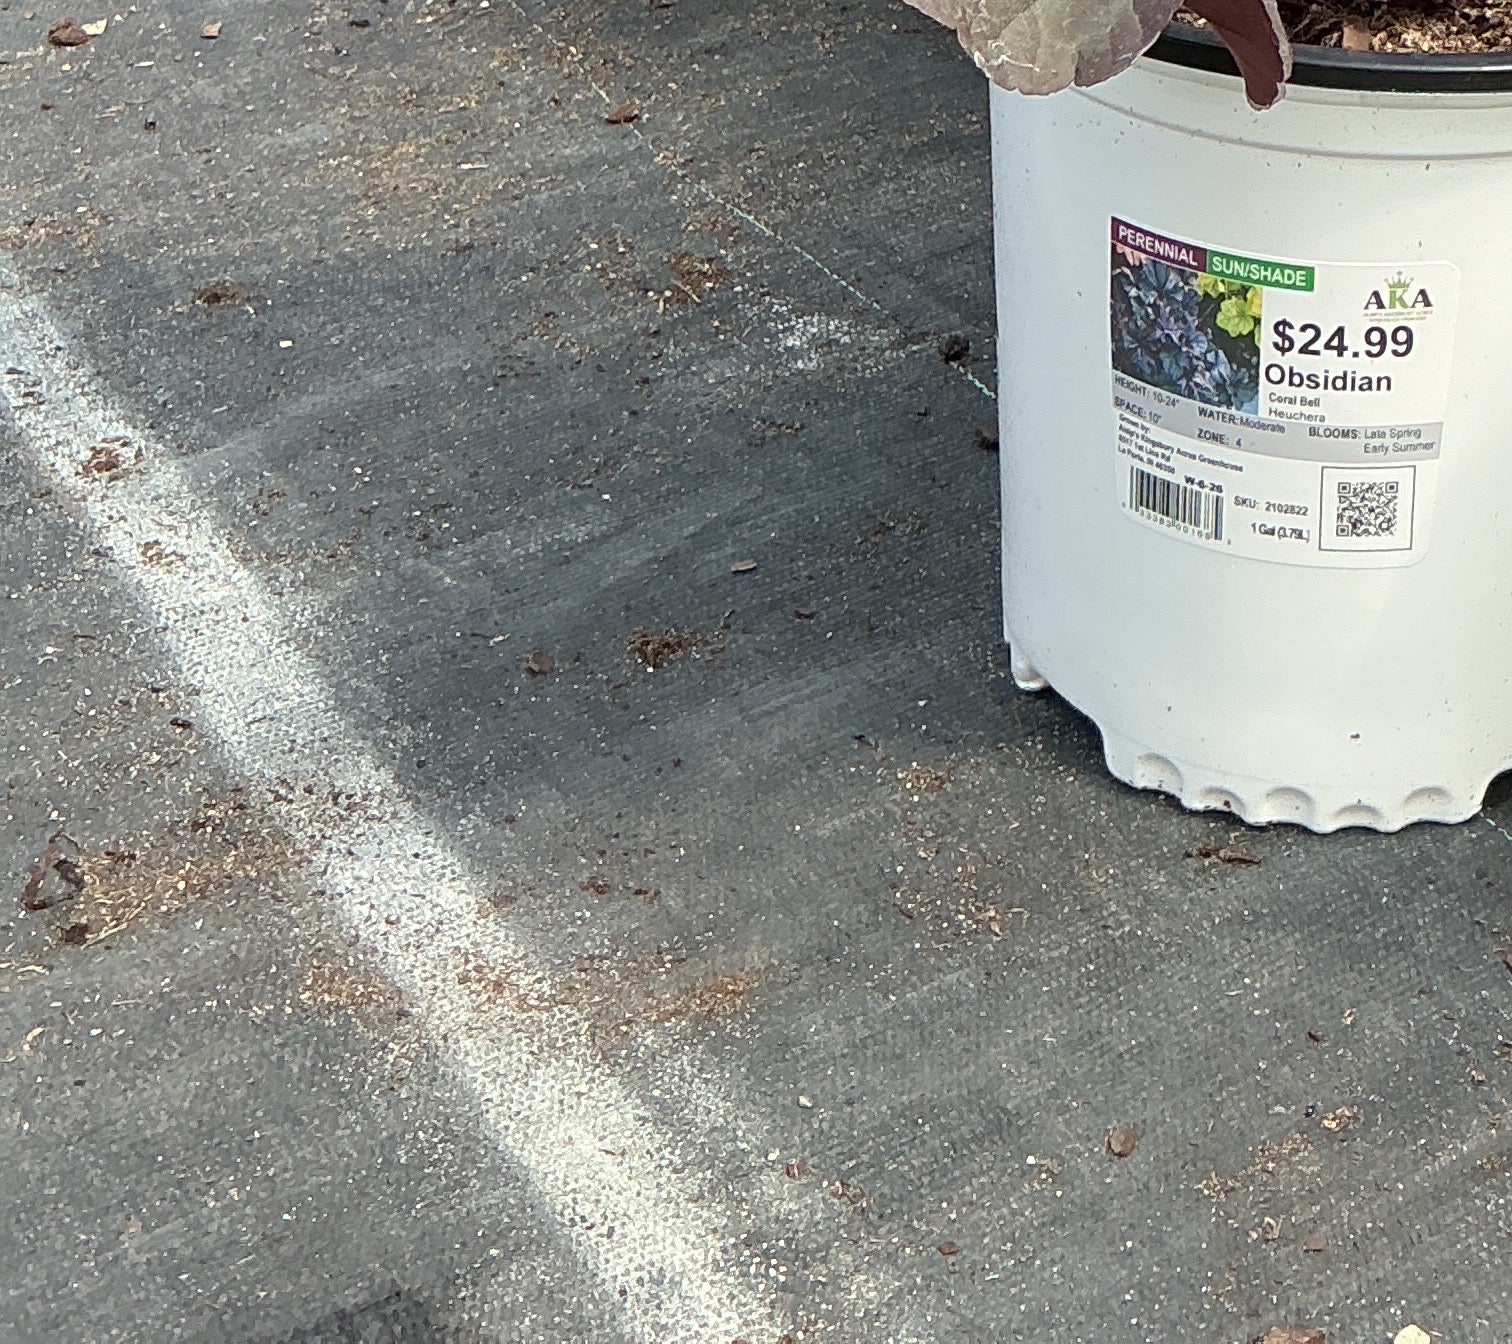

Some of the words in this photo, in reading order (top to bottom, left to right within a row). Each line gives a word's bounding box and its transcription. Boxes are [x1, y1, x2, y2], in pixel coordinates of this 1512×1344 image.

[1118, 224, 1199, 266] PERENNIAL
[1212, 255, 1307, 287] SUN/SHADE
[1272, 317, 1415, 358] $24.99
[1264, 363, 1393, 393] Obsidian
[1268, 392, 1297, 406] Coral
[1299, 395, 1321, 408] Bell
[1268, 407, 1326, 423] Heuchera
[1308, 426, 1361, 439] BLOOMS:
[1389, 427, 1422, 440] Spring
[1363, 443, 1389, 456] Early
[1392, 441, 1436, 454] Summer
